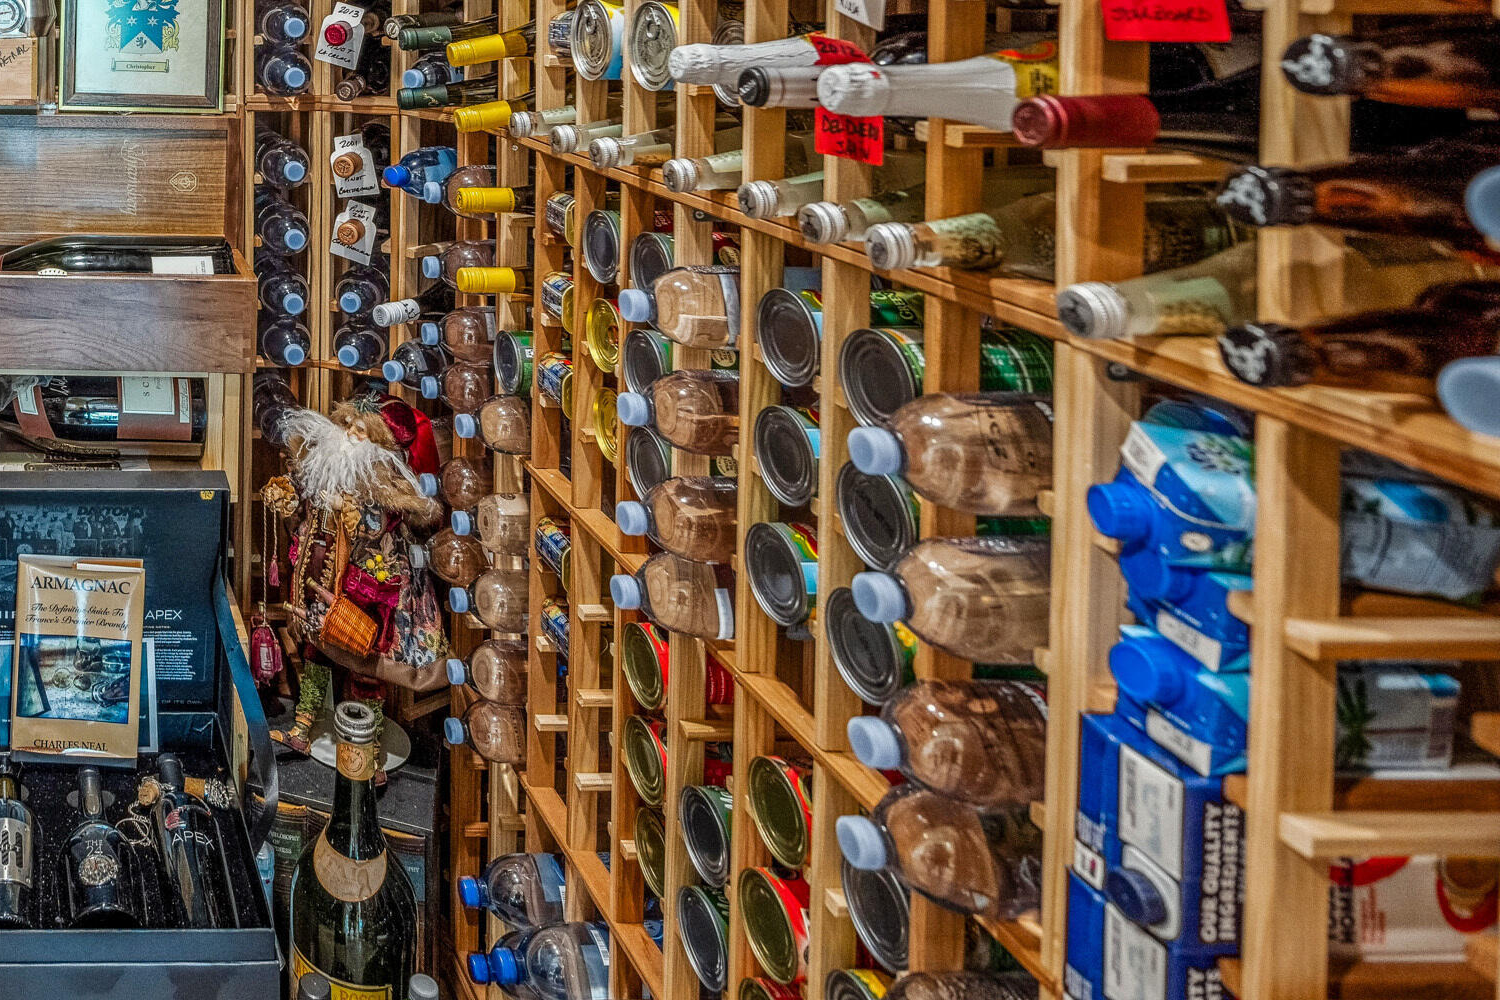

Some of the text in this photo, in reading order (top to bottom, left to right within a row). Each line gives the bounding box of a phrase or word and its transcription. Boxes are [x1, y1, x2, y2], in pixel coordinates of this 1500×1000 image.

[338, 5, 360, 18] 2013
[125, 63, 156, 71] Christopher
[339, 139, 359, 149] 2001
[30, 576, 132, 595] ARMAGNAC
[31, 603, 48, 613] The
[87, 606, 109, 617] Guide
[112, 608, 125, 617] To
[145, 609, 183, 621] APEX
[25, 614, 60, 625] France's
[96, 619, 130, 631] Brandy
[33, 739, 109, 752] CHARLES NEAL
[171, 830, 216, 850] APEX
[1200, 803, 1222, 943] OUR QUALITY
[1218, 804, 1240, 941] INGREDIENTS
